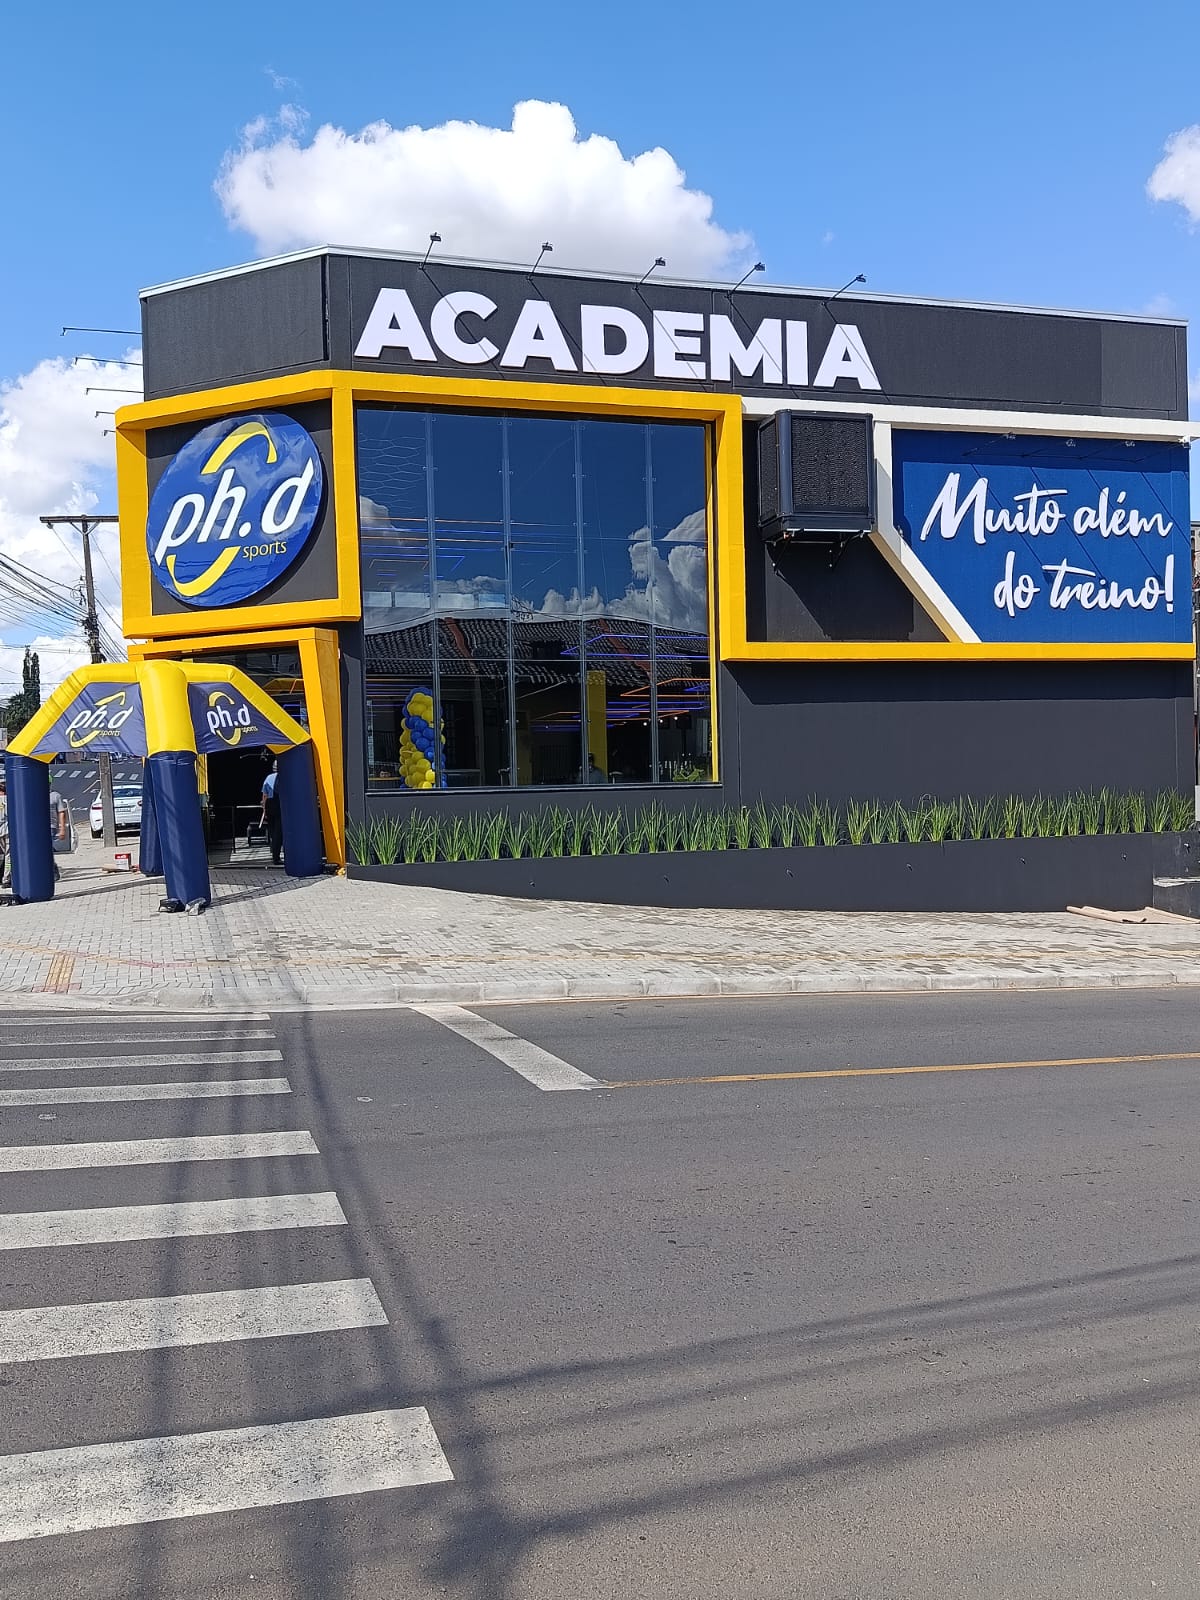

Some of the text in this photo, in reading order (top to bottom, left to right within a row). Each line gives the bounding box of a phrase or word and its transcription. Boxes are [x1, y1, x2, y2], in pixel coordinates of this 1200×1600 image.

[354, 287, 882, 390] ACADEMIA
[154, 457, 314, 567] ph.d
[920, 472, 1173, 544] Muito além
[242, 541, 287, 561] sports
[994, 550, 1174, 617] do treino!
[65, 704, 134, 736] ph.d
[206, 703, 251, 736] ph.d
